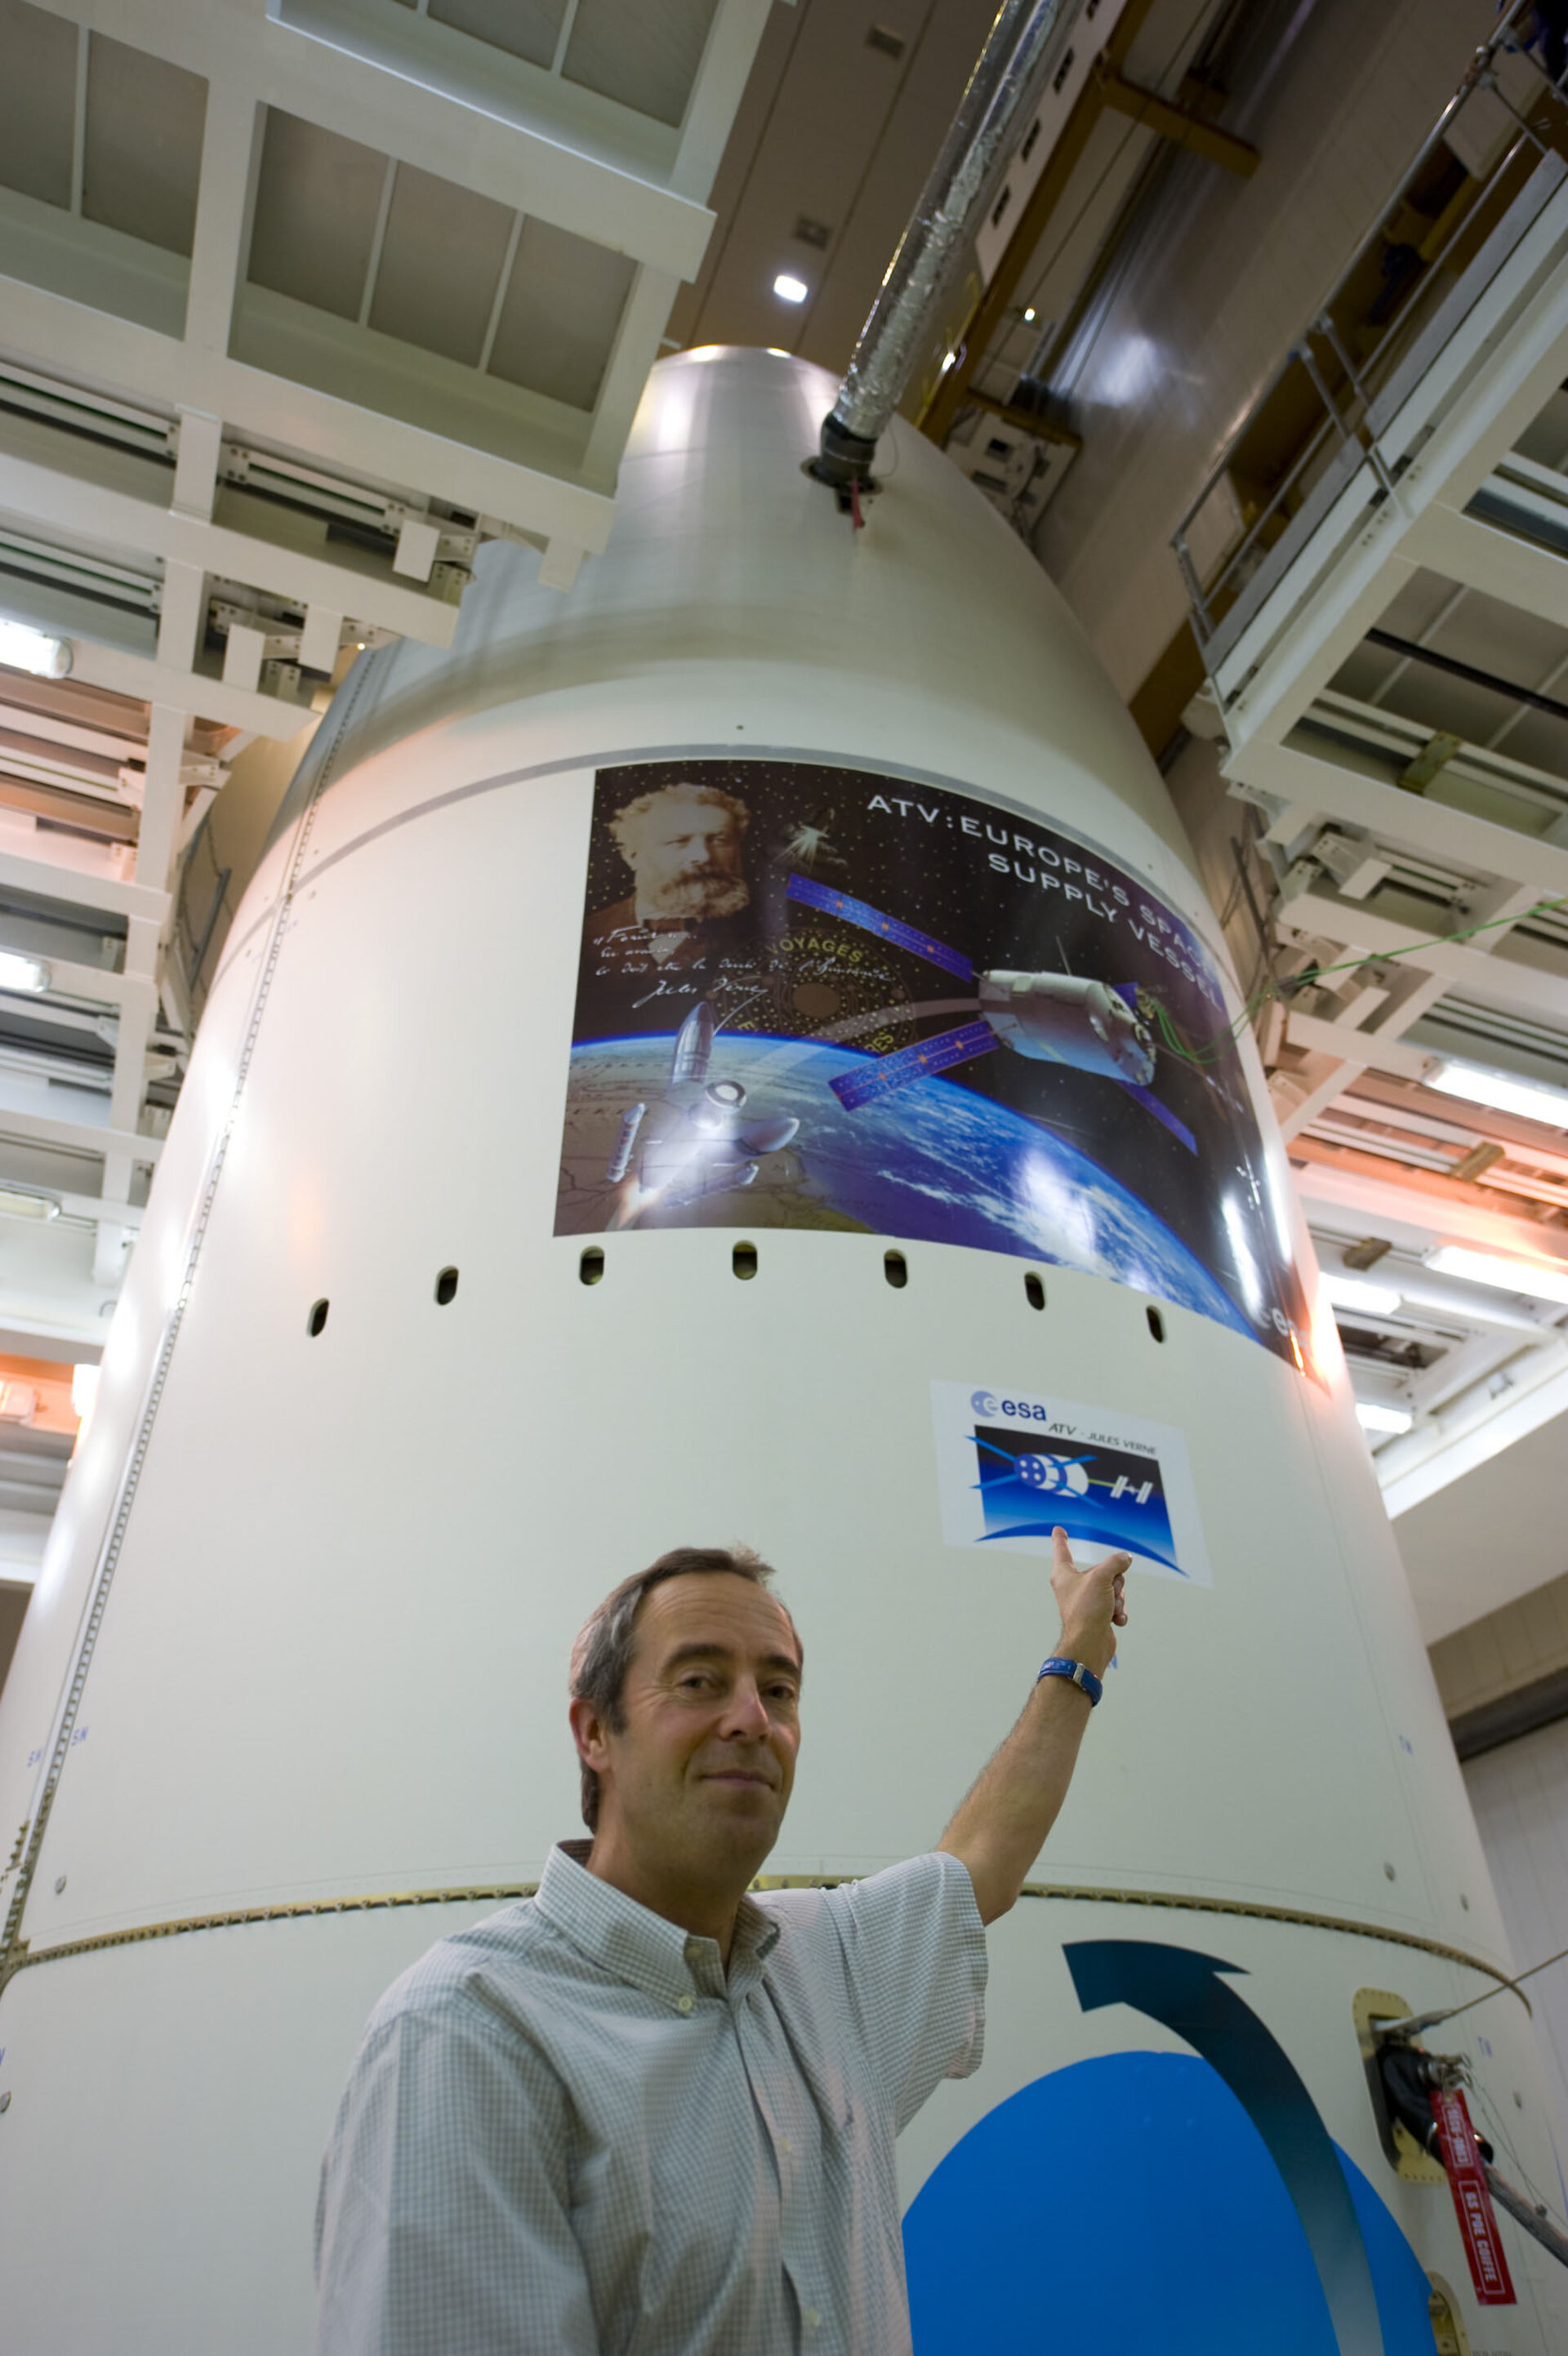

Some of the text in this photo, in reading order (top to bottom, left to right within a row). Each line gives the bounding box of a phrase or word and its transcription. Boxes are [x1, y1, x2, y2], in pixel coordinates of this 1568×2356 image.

[987, 853, 1223, 1013] SUPPLY VESSEL
[764, 938, 862, 963] VOYAGES
[1001, 1399, 1046, 1421] esa
[1049, 1423, 1076, 1436] ATV
[1088, 1431, 1120, 1446] JULES
[1123, 1440, 1156, 1454] VERNE
